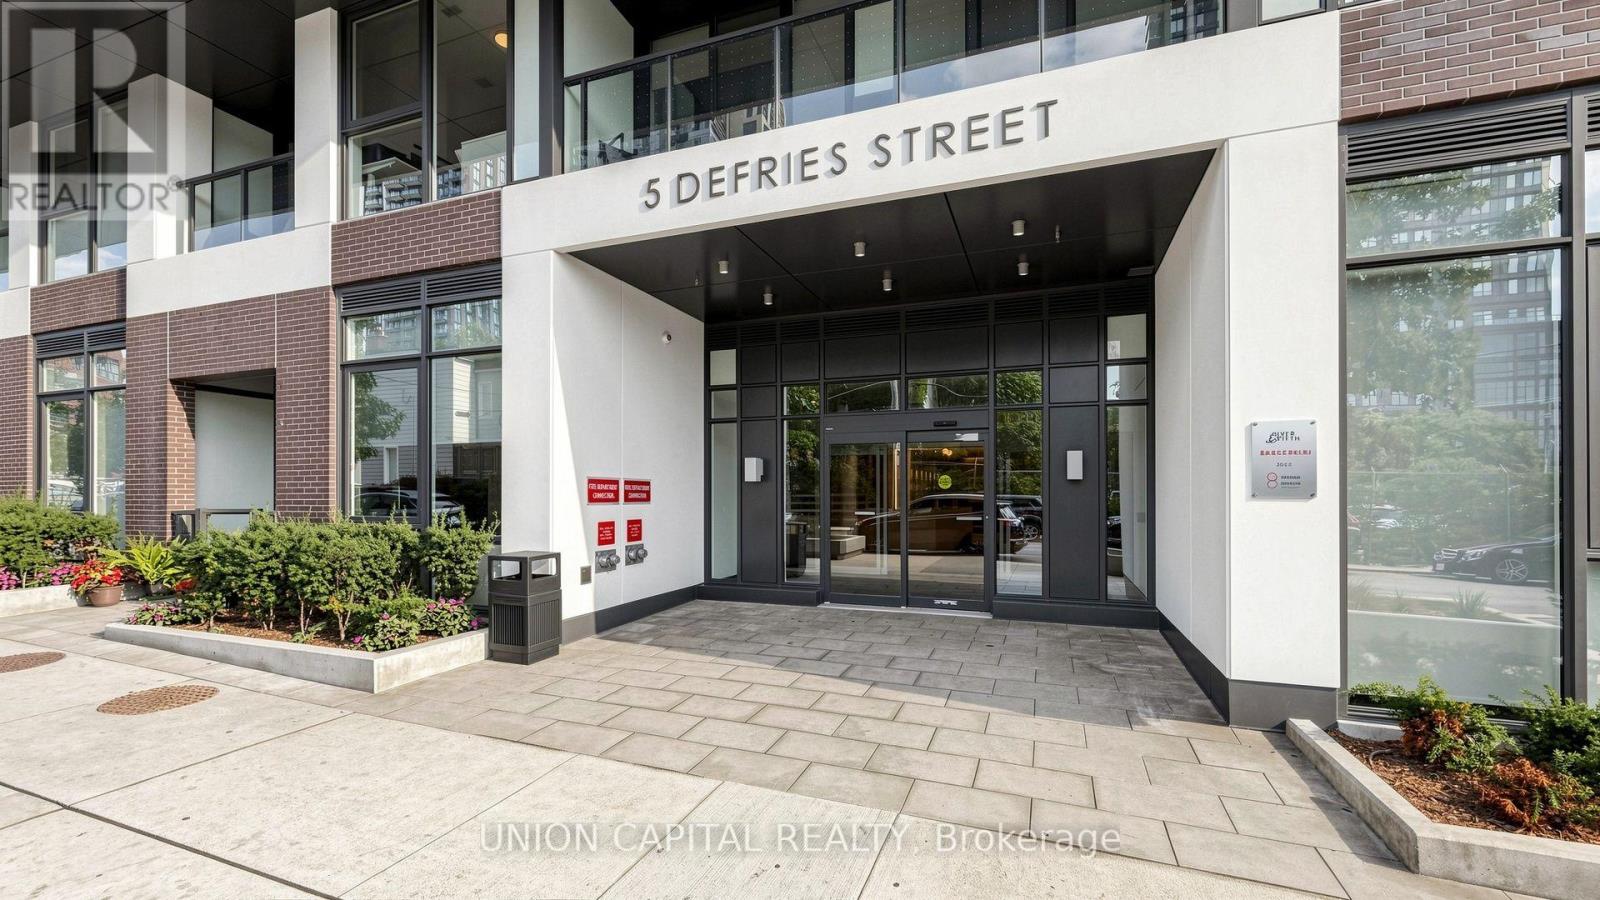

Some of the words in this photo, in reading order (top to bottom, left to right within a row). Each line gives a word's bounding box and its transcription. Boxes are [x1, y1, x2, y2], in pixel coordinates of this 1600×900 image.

[644, 177, 661, 209] 5
[676, 141, 848, 204] DEFRIES
[872, 99, 1059, 168] STREET
